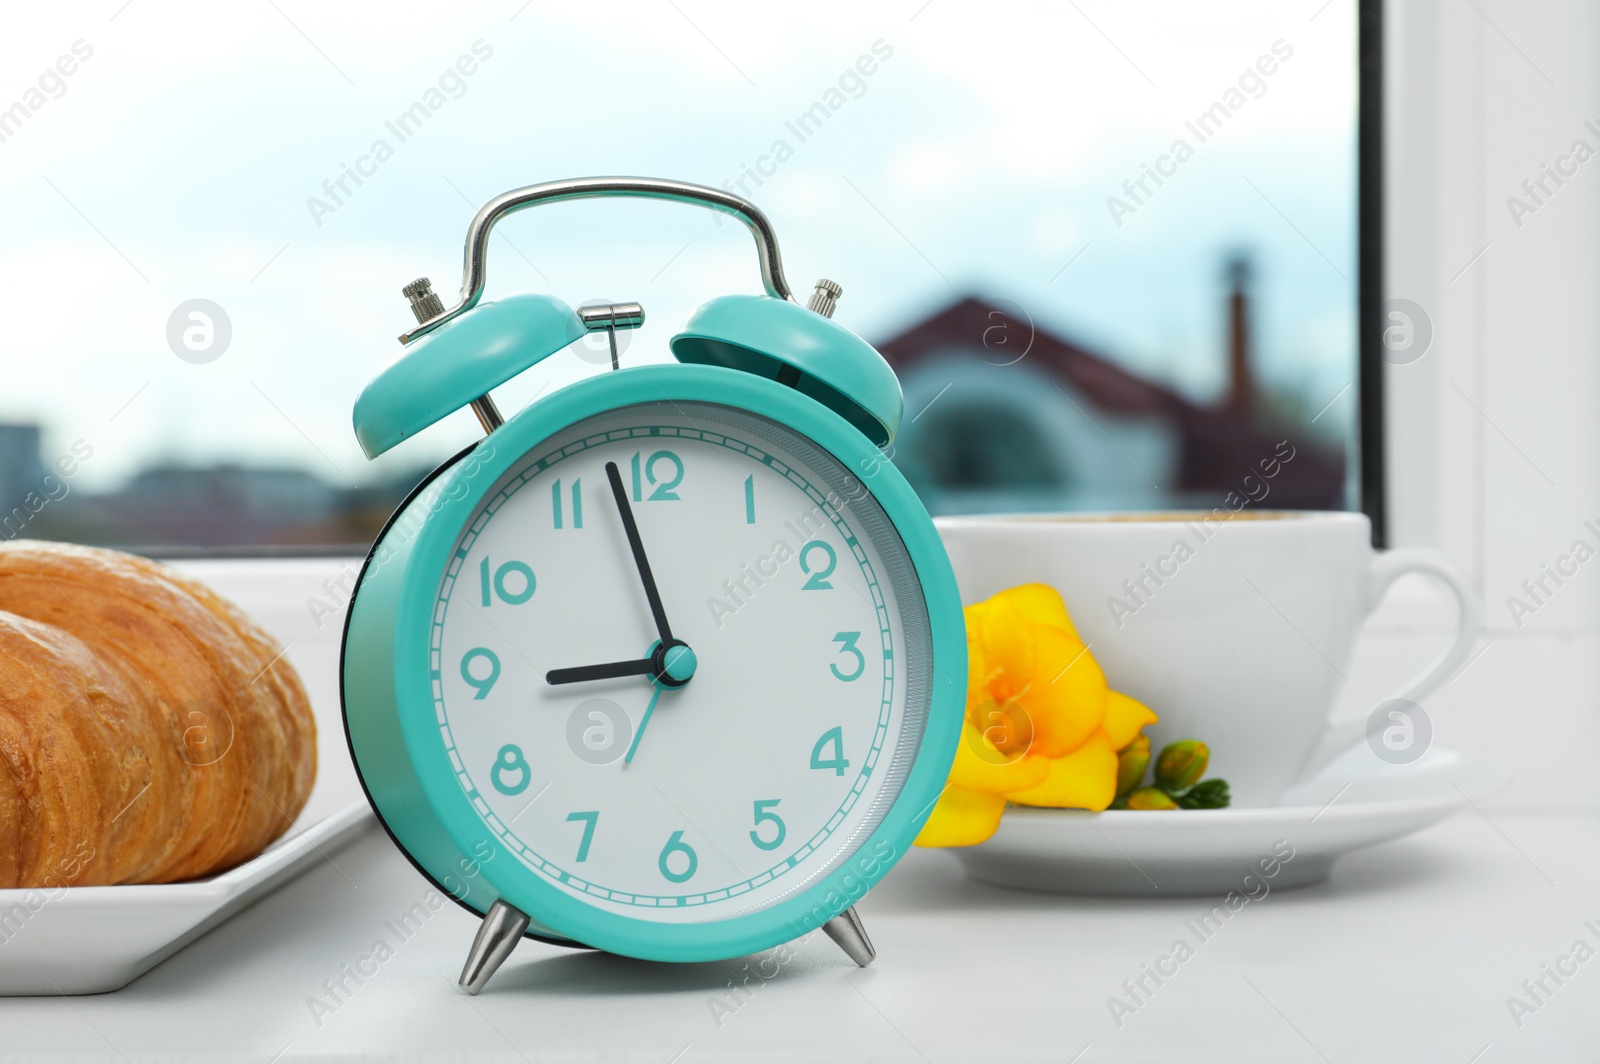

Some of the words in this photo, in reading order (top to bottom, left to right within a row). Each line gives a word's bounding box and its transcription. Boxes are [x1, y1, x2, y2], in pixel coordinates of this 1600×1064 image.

[631, 450, 684, 502] 12
[745, 475, 755, 524] 1
[552, 478, 582, 529] 11
[480, 556, 536, 606] 10
[800, 540, 836, 590] 2
[460, 648, 500, 700] 9
[830, 632, 865, 682] 3
[491, 744, 531, 796] 8
[810, 727, 849, 776] 4
[567, 812, 598, 862] 7
[750, 800, 786, 850] 5
[659, 831, 698, 883] 6
